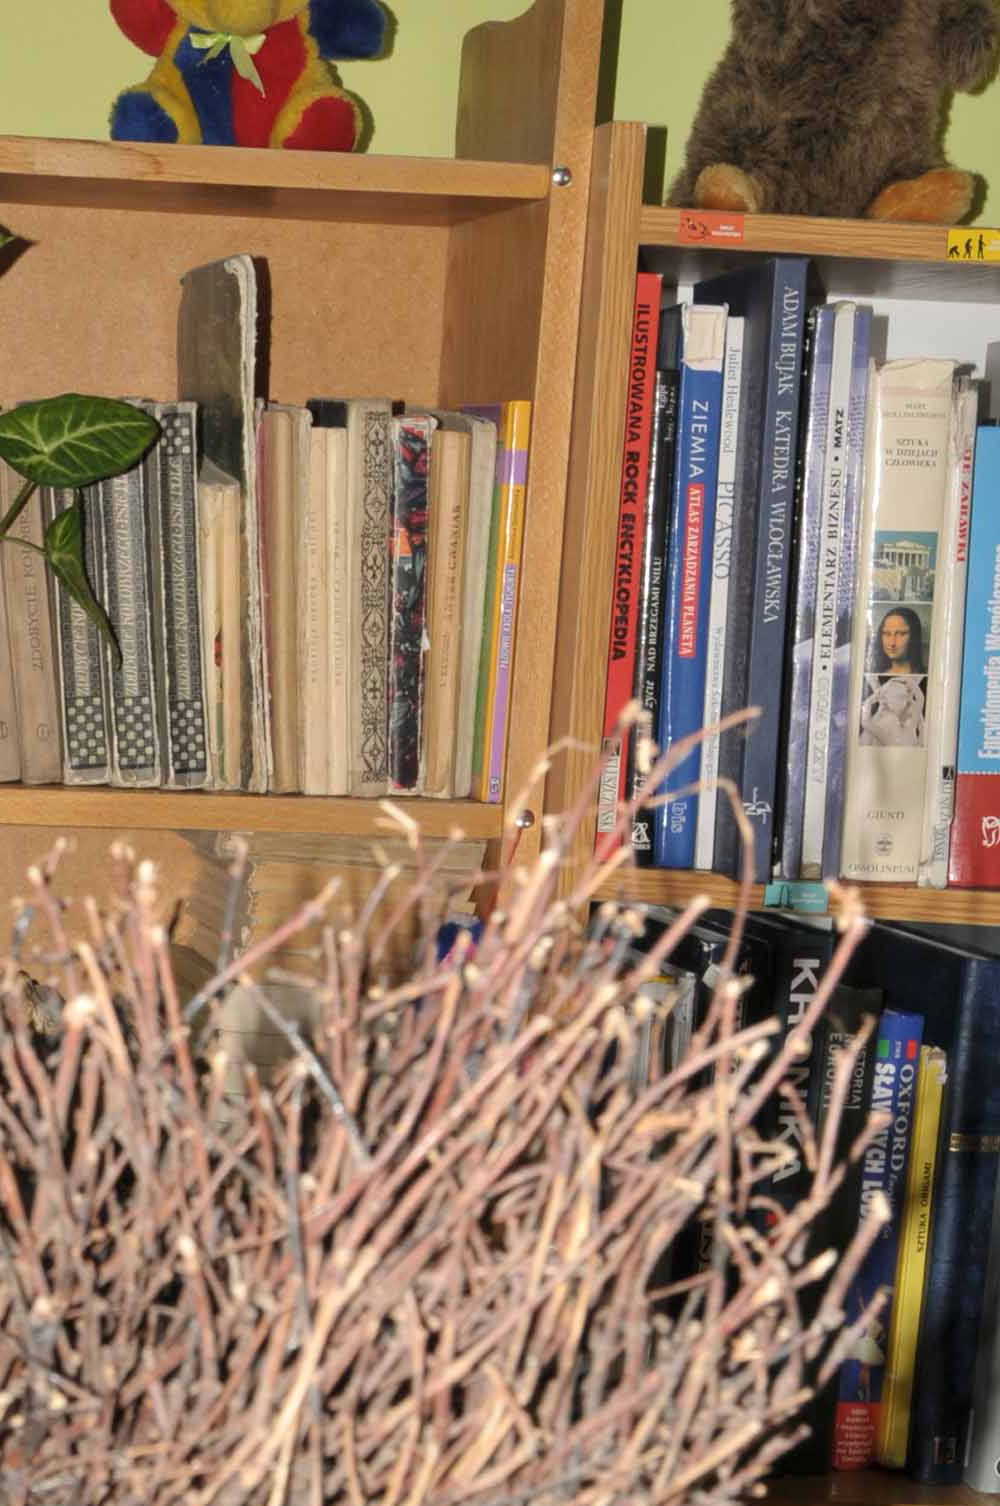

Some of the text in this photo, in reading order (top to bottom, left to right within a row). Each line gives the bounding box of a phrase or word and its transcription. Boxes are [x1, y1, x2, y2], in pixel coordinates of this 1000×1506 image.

[688, 399, 709, 479] ZIEMIA
[722, 346, 741, 454] Juliet Heslewood
[833, 408, 844, 448] MATZ
[611, 303, 651, 661] ILUSTROWANA ROCK ENCYKLOPEDIA
[763, 286, 800, 623] ADAM BUJAK KATEDRA WŁOCŁAWSKA
[687, 487, 702, 523] ATLAS
[714, 481, 737, 580] PICASSO
[826, 468, 841, 538] BIZNESU
[651, 556, 662, 585] NILU
[682, 526, 699, 602] ZARZĄDZANIA
[820, 547, 836, 659] ELEMENTARZ
[24, 585, 44, 671] ZDOBYCIE
[648, 587, 661, 645] BRZEGAMI
[646, 647, 657, 672] NAD
[847, 863, 915, 874] OSSOLINEUM
[890, 1063, 915, 1171] OXFORD
[916, 1162, 932, 1253] SZTUKA ORIGAMI
